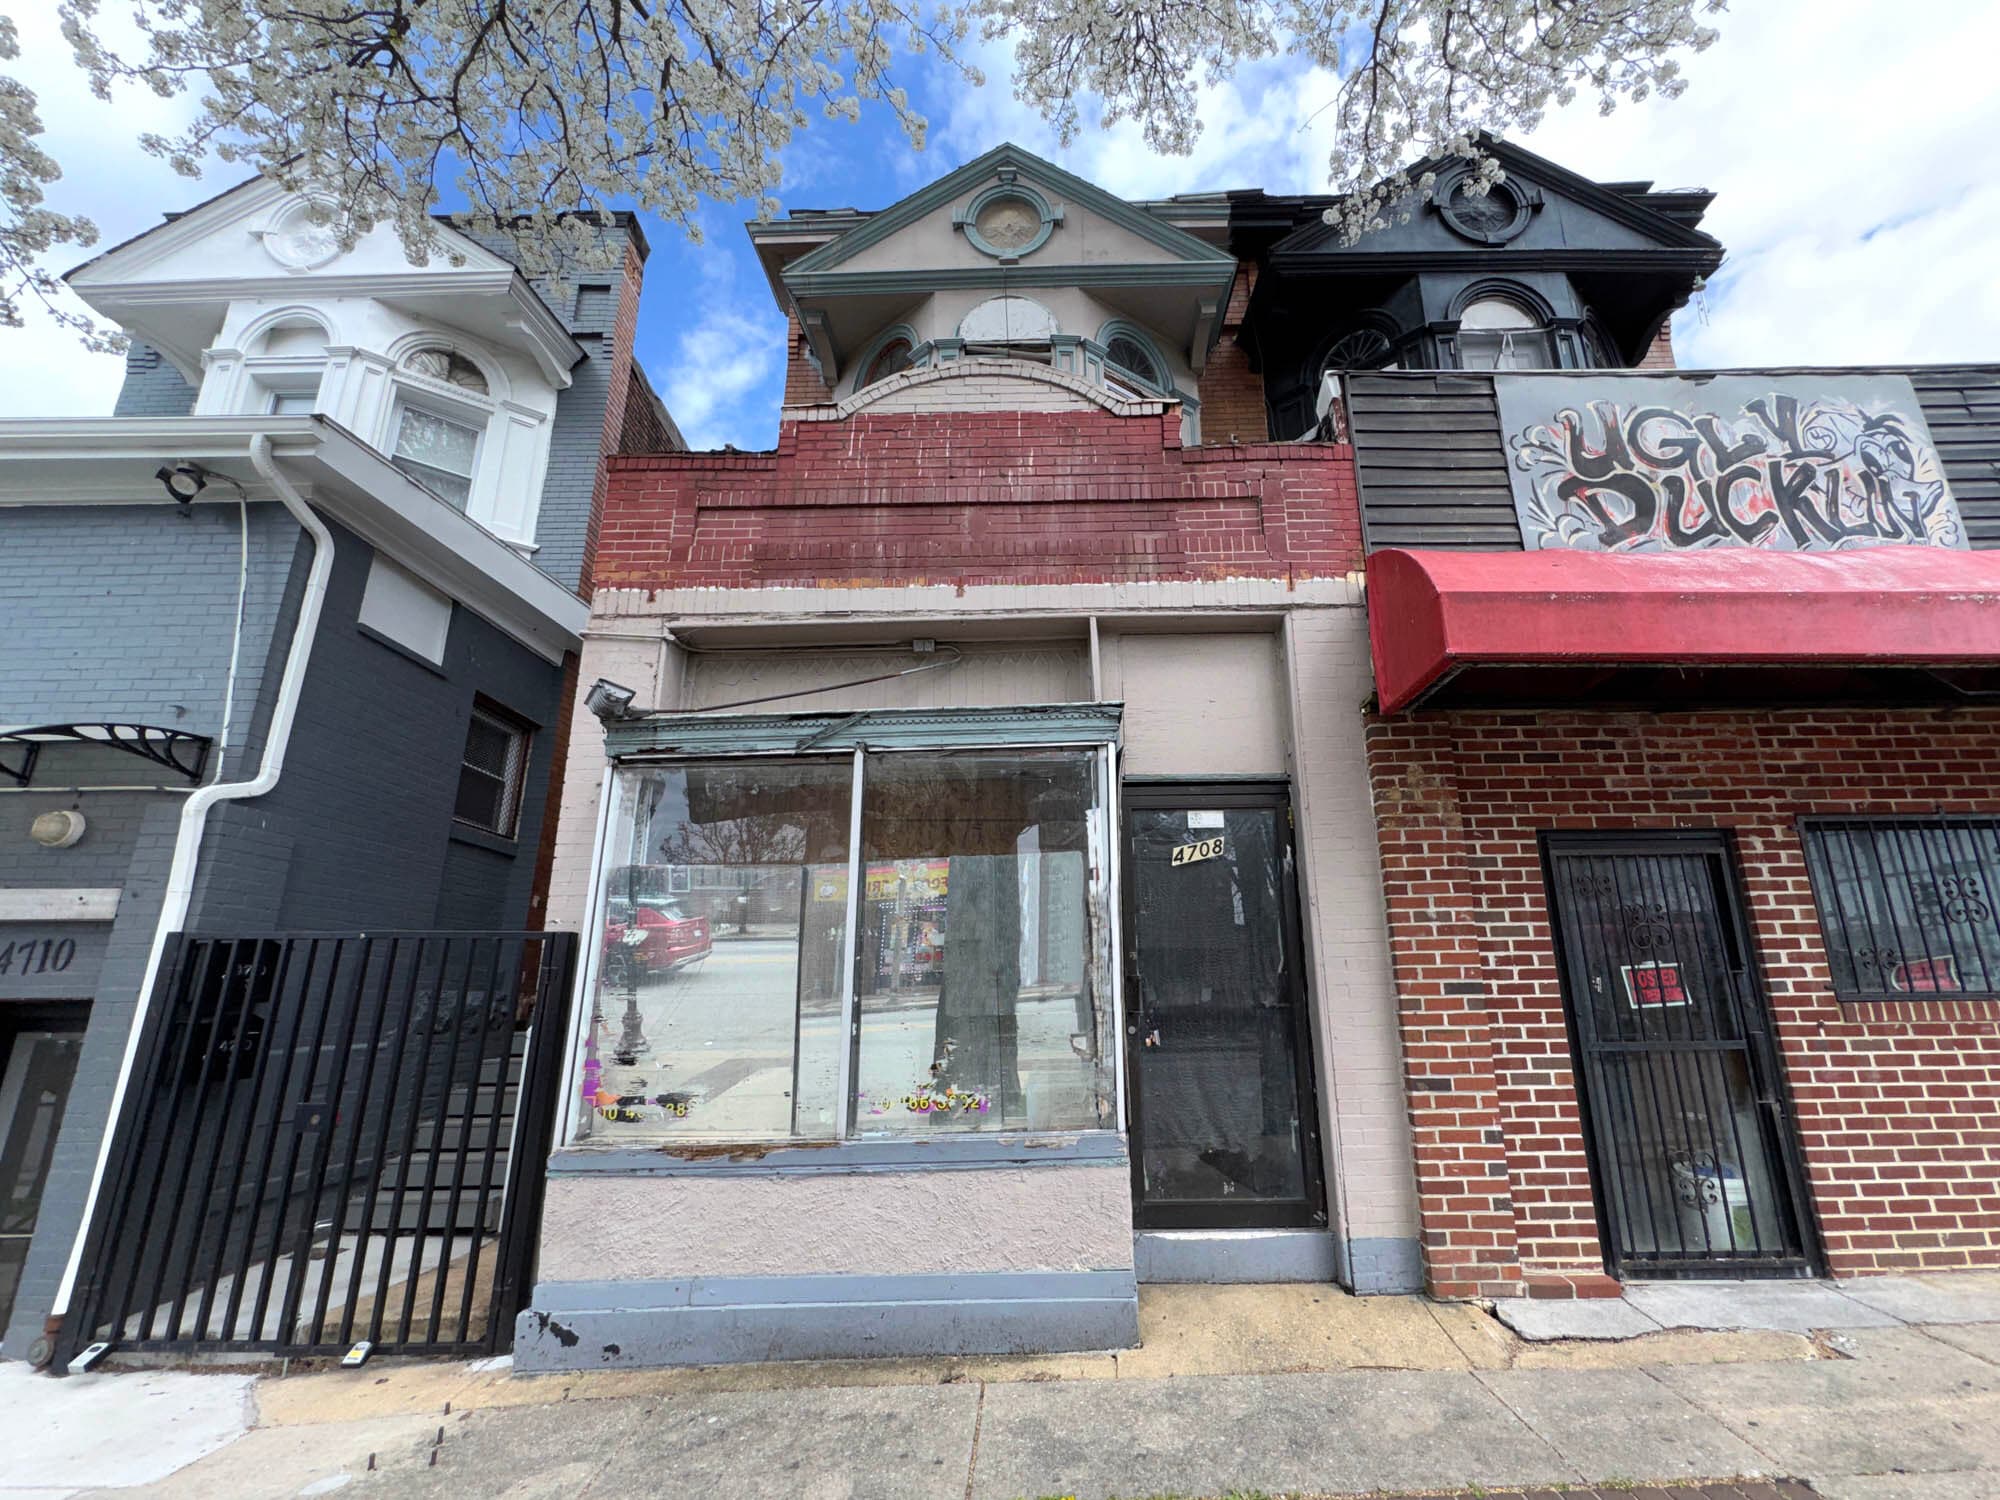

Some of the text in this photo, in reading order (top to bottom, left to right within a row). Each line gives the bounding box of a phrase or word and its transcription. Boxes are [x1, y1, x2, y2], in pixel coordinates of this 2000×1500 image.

[1554, 393, 1836, 481] UGLY
[1173, 839, 1223, 863] 4708
[0, 938, 76, 976] 4710
